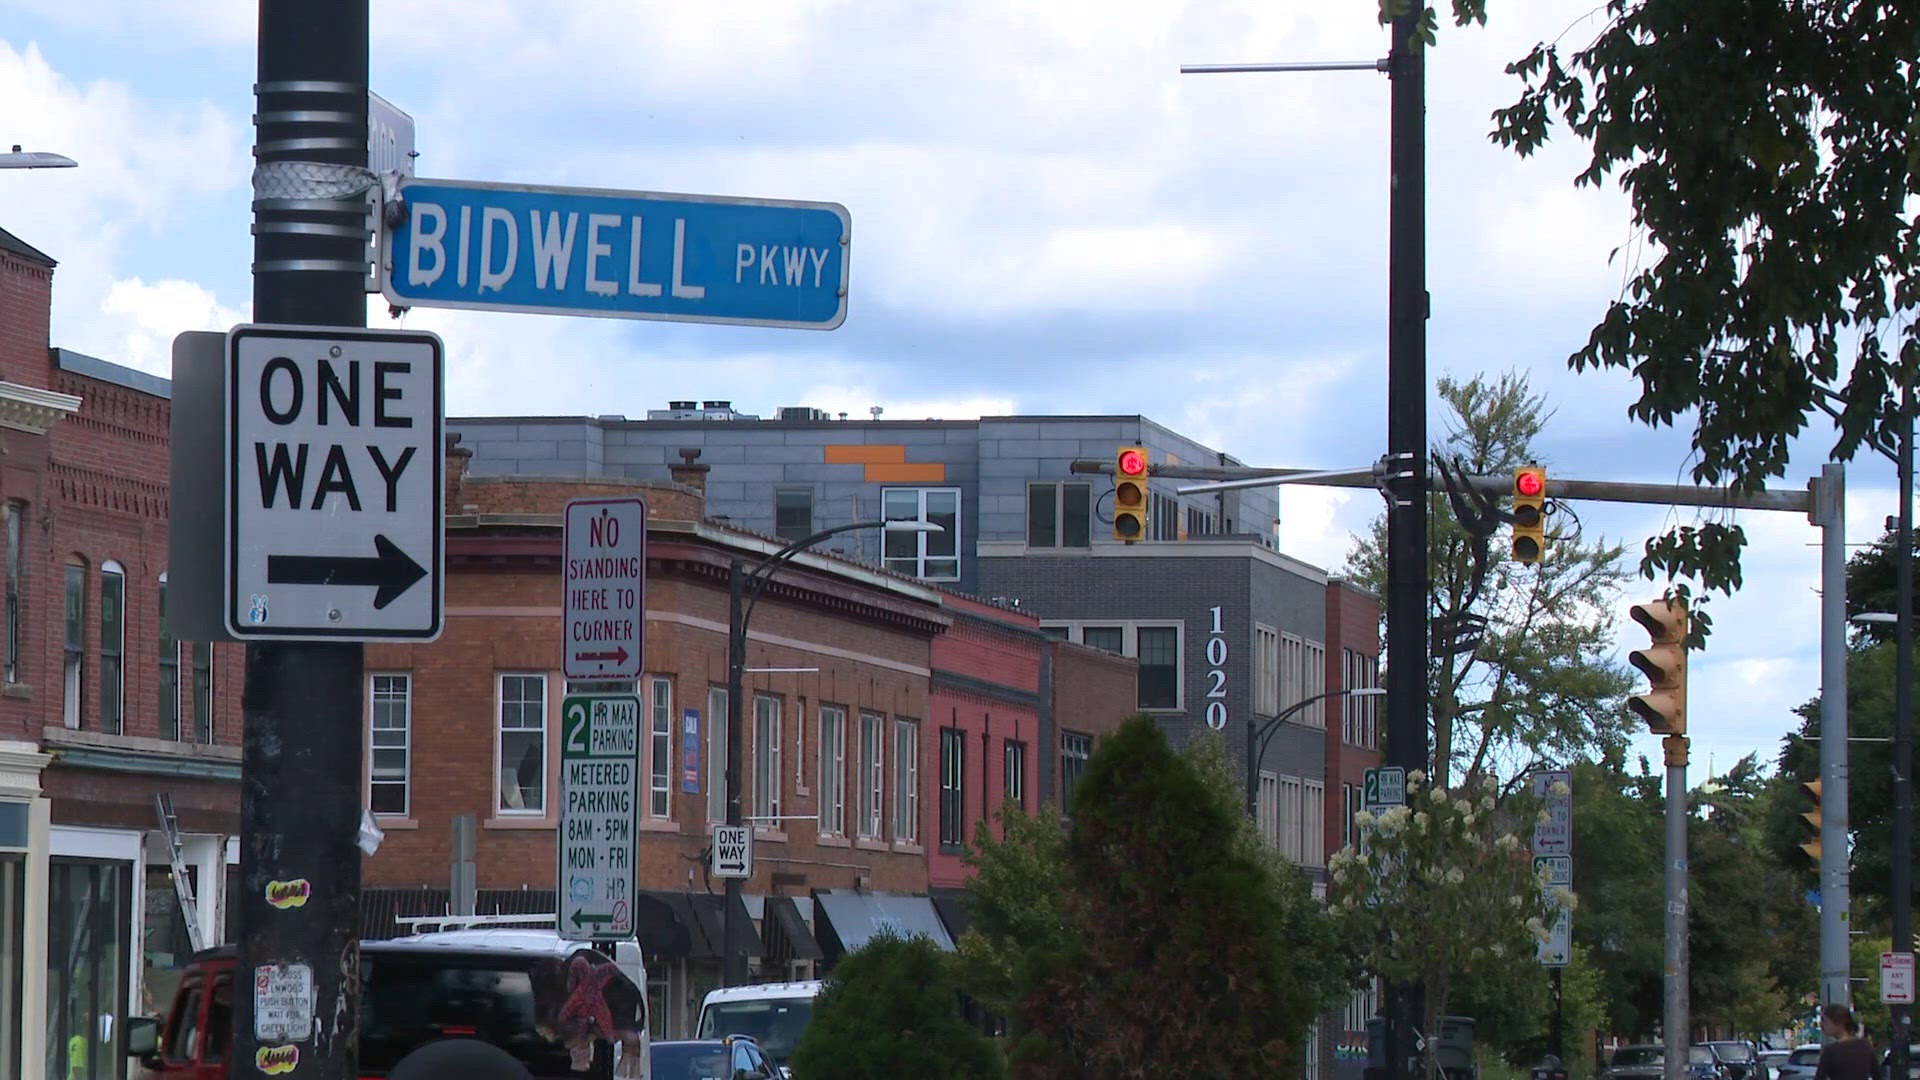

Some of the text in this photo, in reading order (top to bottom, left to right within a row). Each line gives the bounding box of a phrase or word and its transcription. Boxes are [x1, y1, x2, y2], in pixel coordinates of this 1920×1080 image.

[408, 202, 830, 299] BIDWELL PKWY
[259, 356, 413, 429] ONE
[254, 442, 418, 513] WAY
[590, 516, 619, 548] NO
[570, 557, 638, 580] STANDING
[572, 588, 634, 610] HERE TO
[573, 619, 632, 642] CORNER
[1205, 605, 1229, 731] 1020
[594, 703, 634, 726] HR MAX
[566, 703, 587, 752] 2
[592, 728, 634, 752] PARKING
[570, 763, 630, 786] METERED
[1367, 773, 1378, 801] 2
[569, 791, 630, 813] PARKING
[568, 819, 593, 841] 8AM
[605, 819, 629, 841] 5PM
[719, 830, 745, 845] ONE
[1537, 825, 1565, 836] CORNER
[568, 847, 595, 869] MON
[609, 847, 628, 869] FRI
[718, 845, 746, 860] WAY
[606, 877, 625, 900] HR
